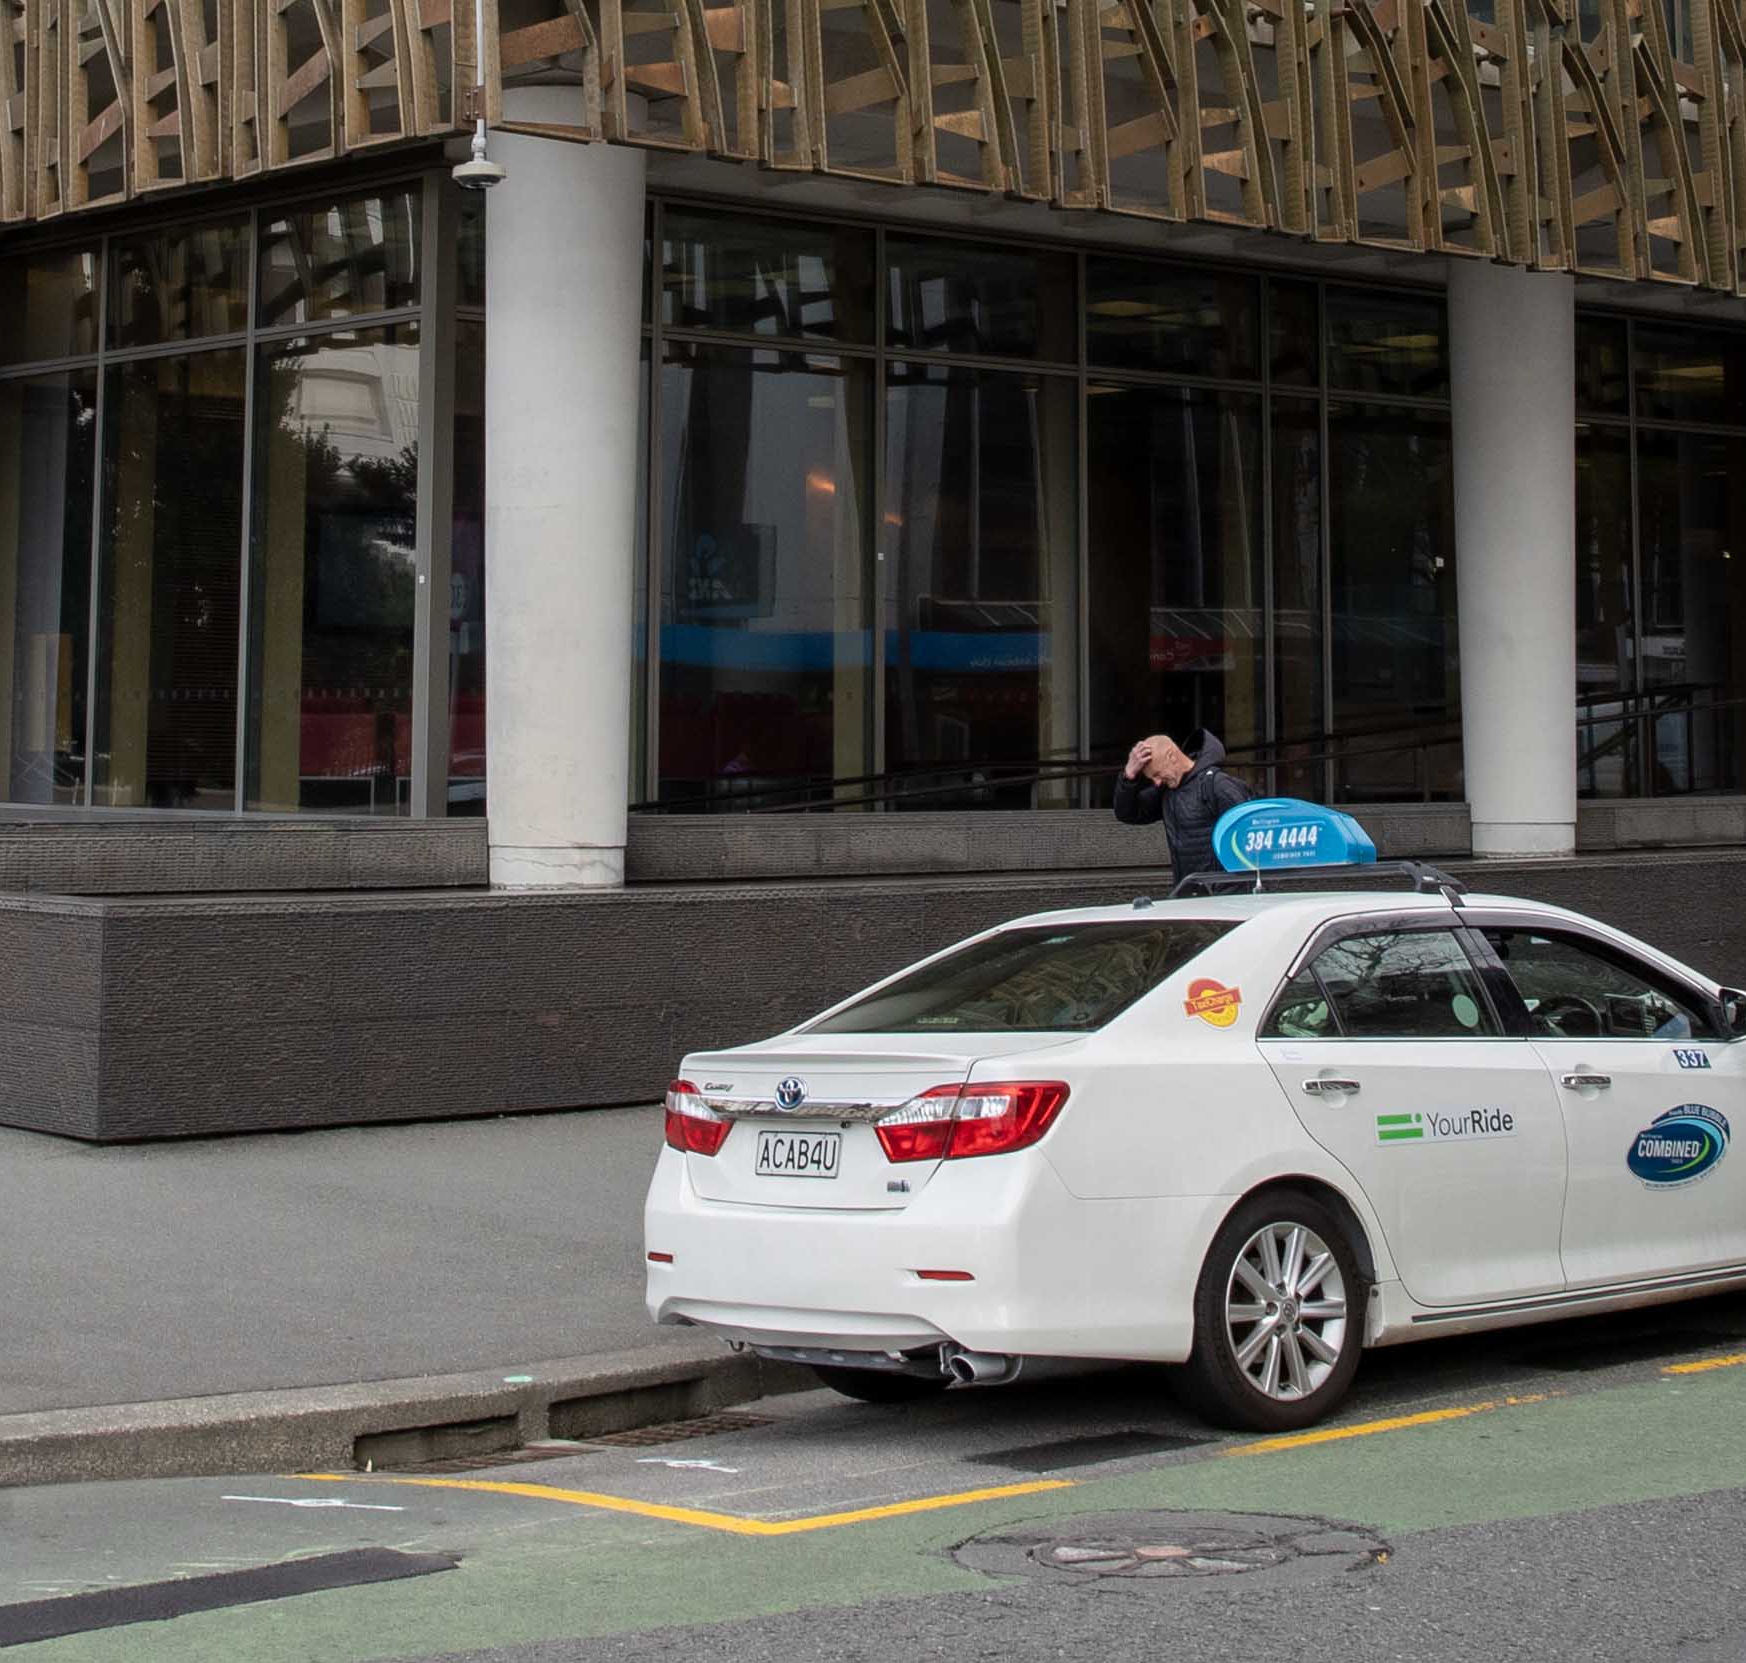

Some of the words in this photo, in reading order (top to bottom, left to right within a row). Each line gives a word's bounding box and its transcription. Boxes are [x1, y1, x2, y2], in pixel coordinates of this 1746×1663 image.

[1245, 829, 1273, 852] 384
[1278, 825, 1318, 848] 4444
[1677, 1050, 1705, 1067] 337
[1426, 1108, 1514, 1137] YourRide
[759, 1138, 837, 1170] ACAB4U
[1638, 1139, 1700, 1158] COMBINED
